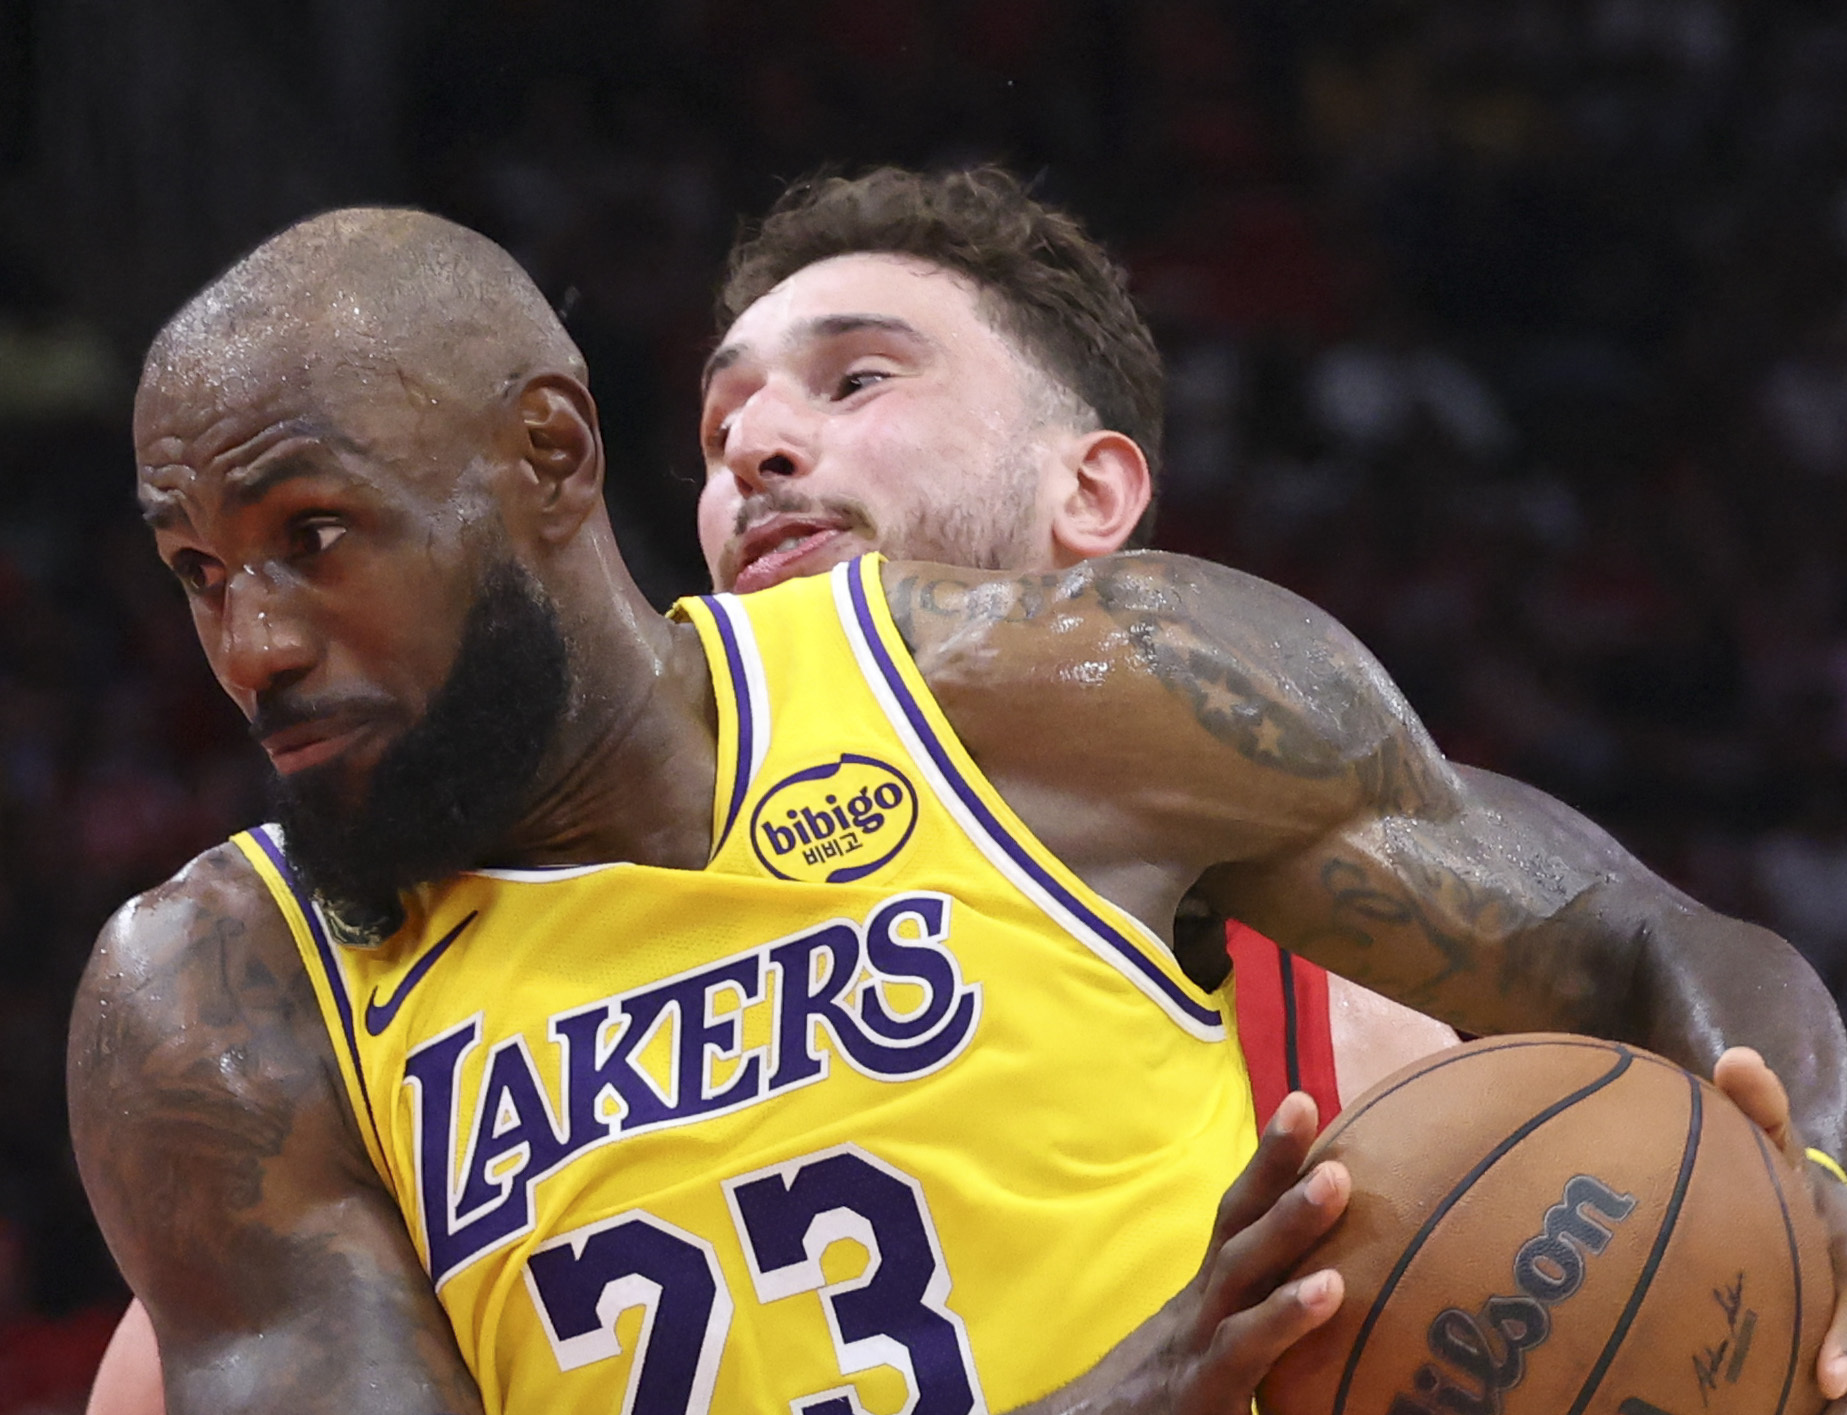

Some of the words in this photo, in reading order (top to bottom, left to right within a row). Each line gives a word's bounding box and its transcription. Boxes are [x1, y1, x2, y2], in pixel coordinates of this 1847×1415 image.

[761, 782, 903, 856] bibigo
[802, 832, 863, 866] 비비고
[401, 890, 983, 1294] LAKERS
